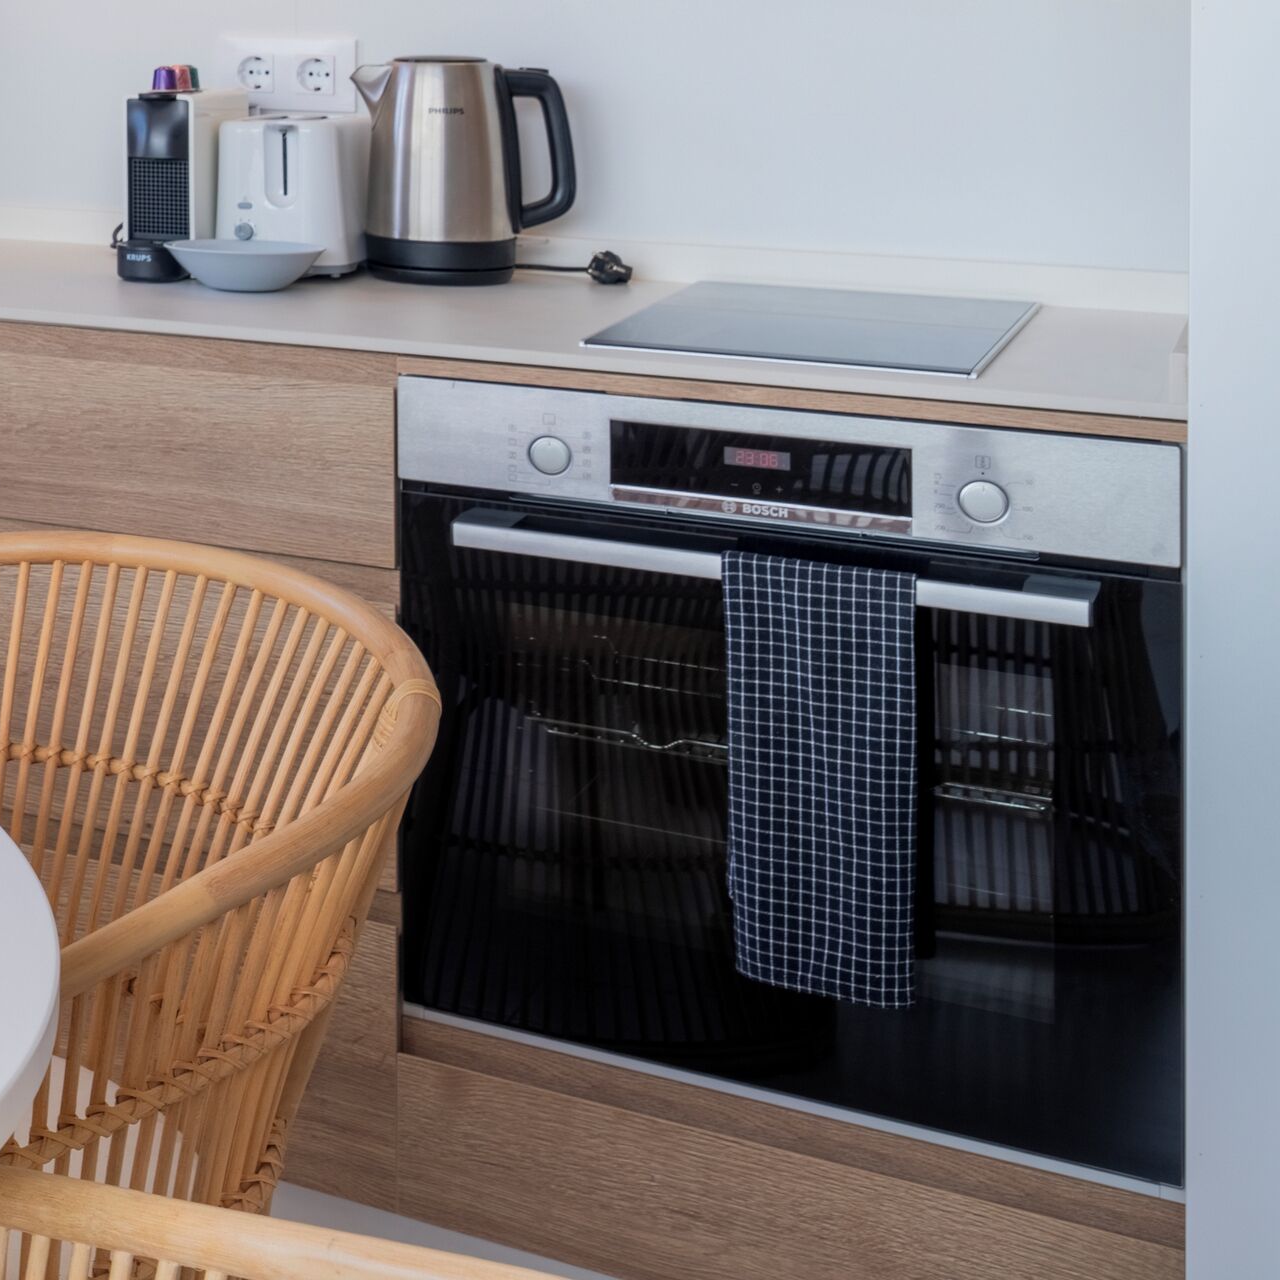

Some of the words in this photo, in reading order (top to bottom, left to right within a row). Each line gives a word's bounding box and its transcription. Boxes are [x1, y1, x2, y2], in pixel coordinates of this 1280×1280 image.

[428, 107, 465, 116] PHILIPS
[126, 253, 152, 262] KRUPS
[742, 503, 789, 518] BOSCH
